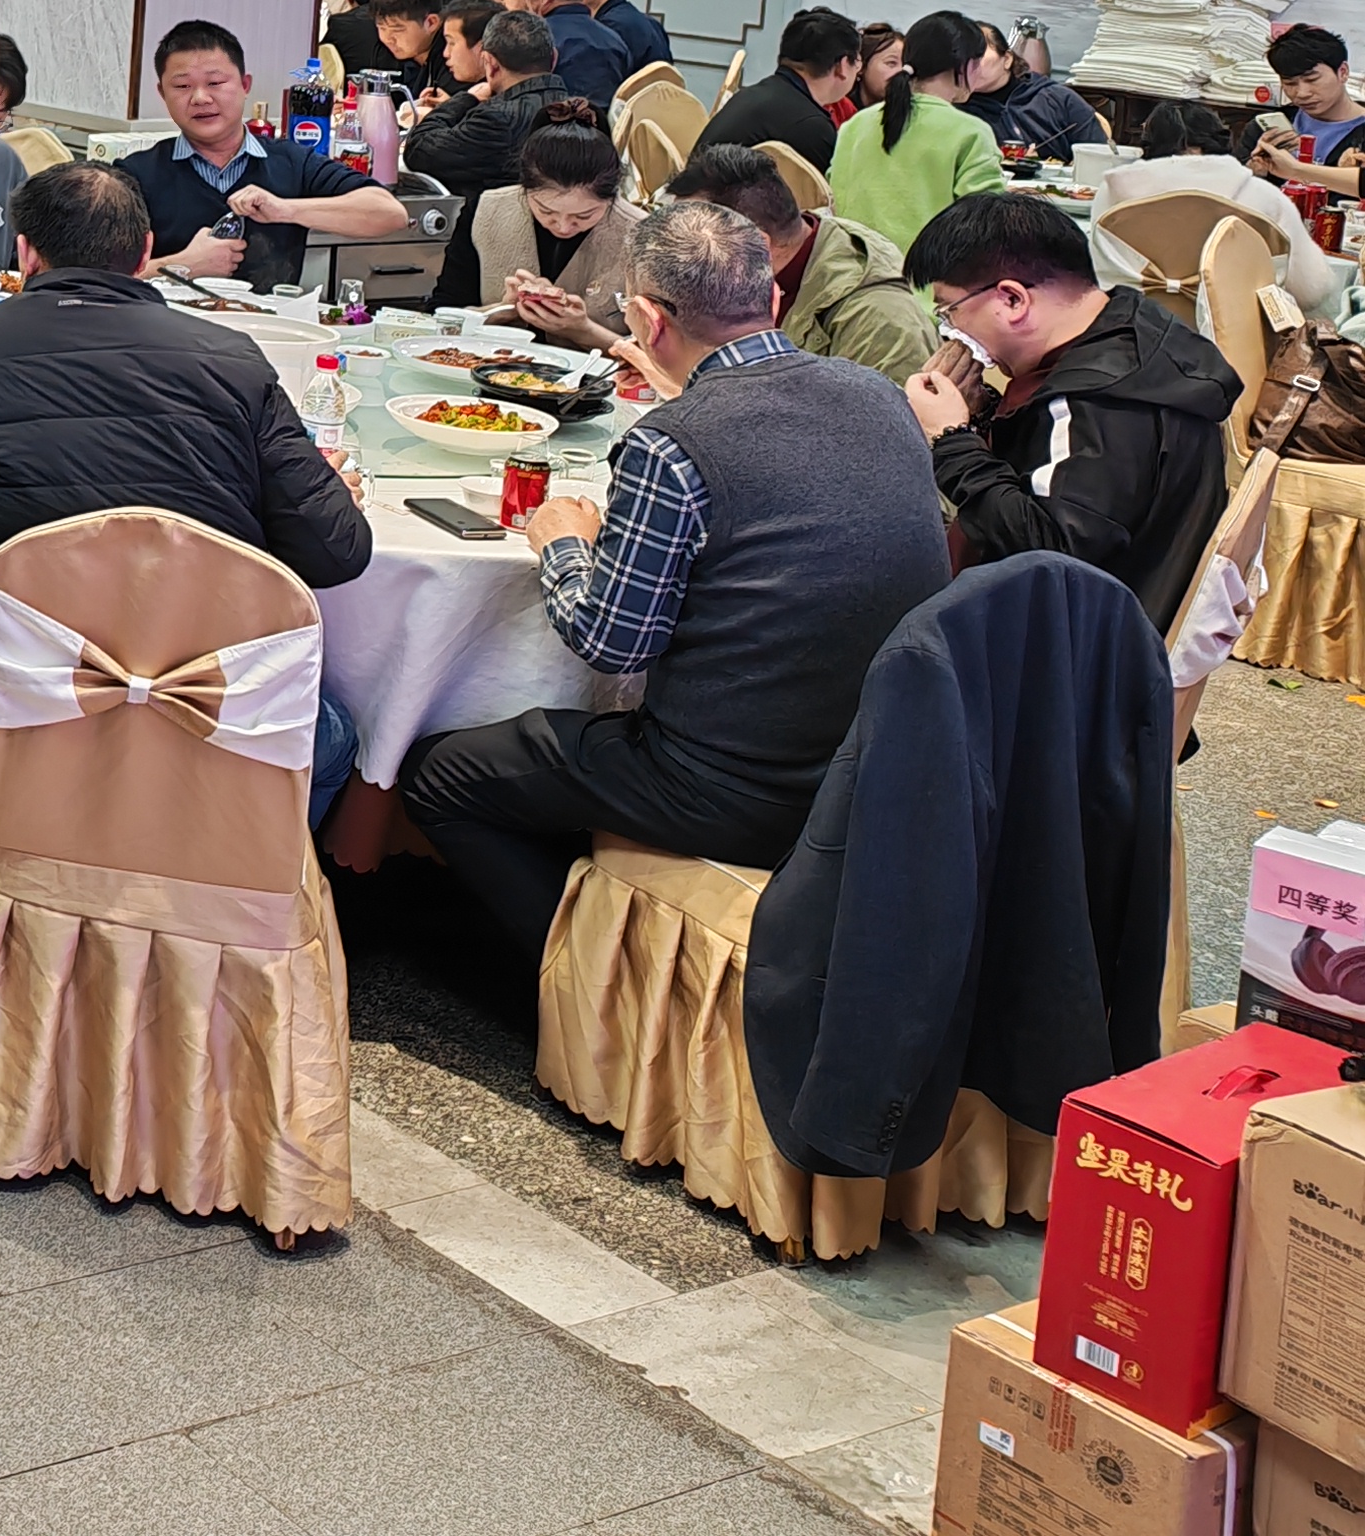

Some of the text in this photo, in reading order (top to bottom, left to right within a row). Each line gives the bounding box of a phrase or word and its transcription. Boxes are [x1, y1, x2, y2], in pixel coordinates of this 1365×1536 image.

[1278, 885, 1358, 926] 四等奖
[1076, 1132, 1193, 1212] 坚果有礼
